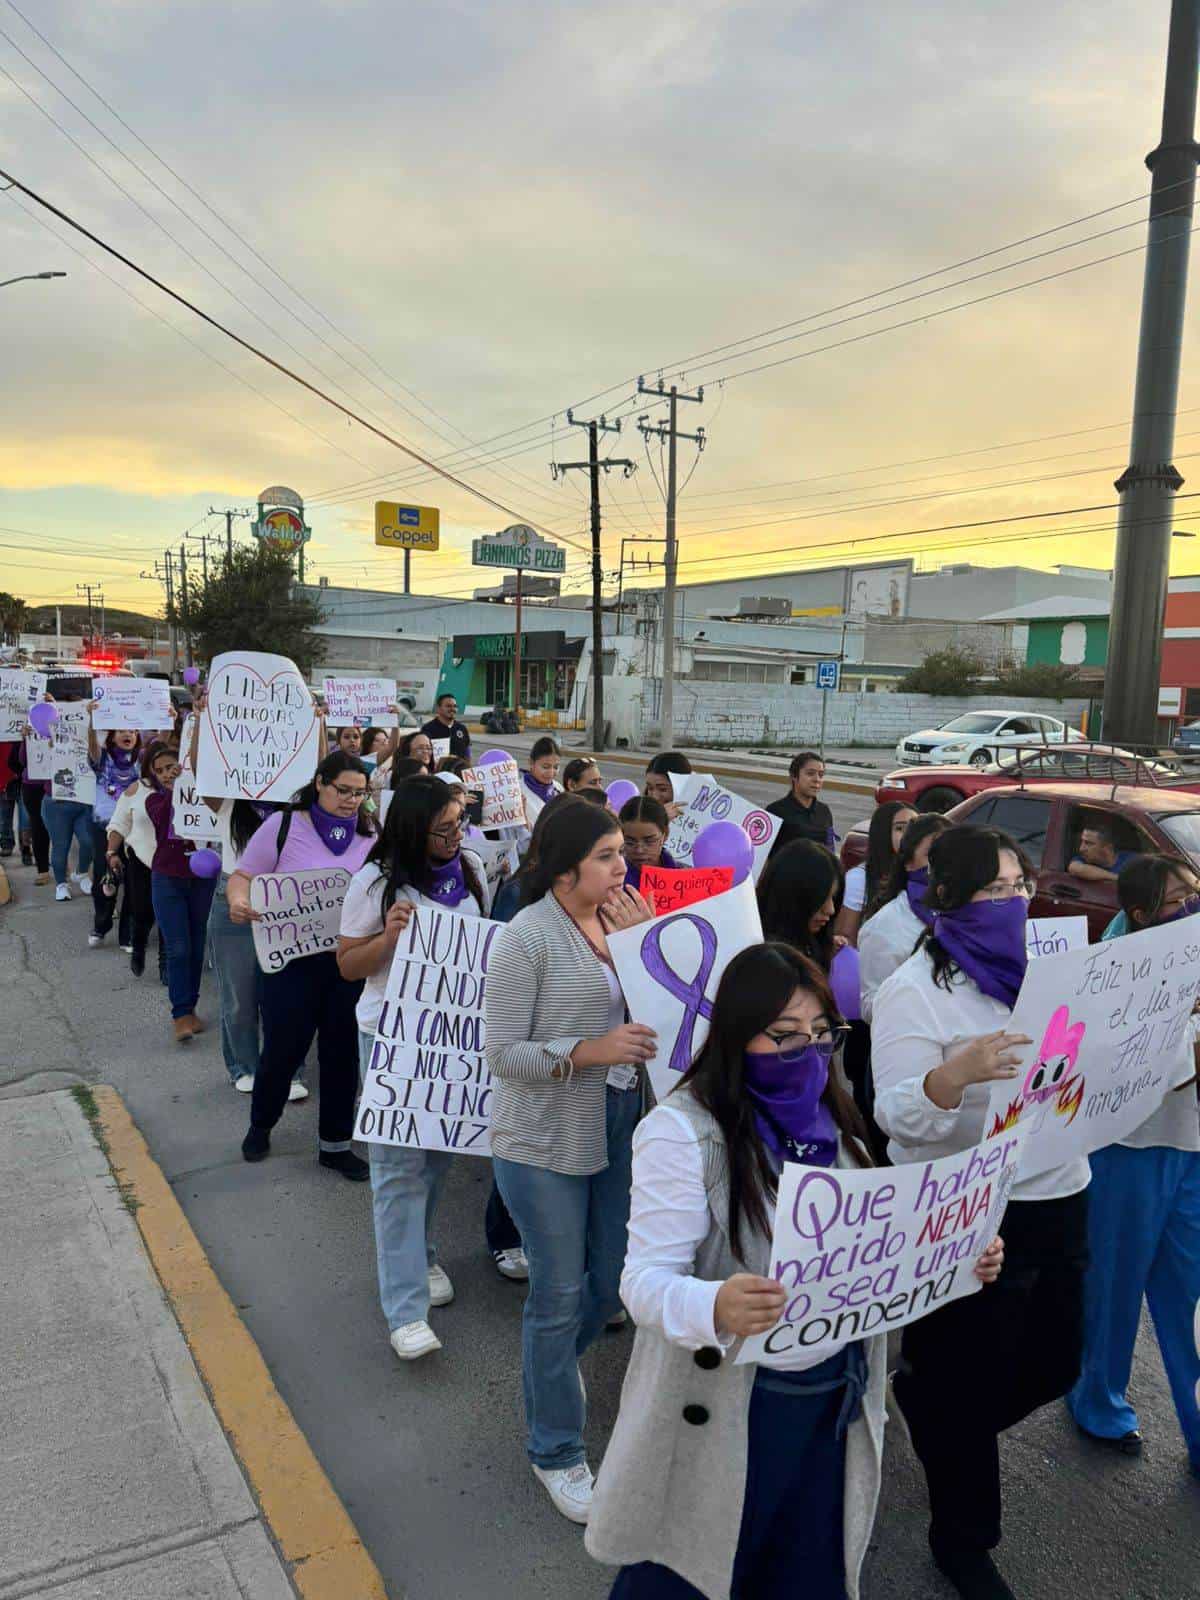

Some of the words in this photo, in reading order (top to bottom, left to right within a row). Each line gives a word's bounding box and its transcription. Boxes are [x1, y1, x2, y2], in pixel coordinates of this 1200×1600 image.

[381, 525, 433, 545] Coppel
[535, 548, 564, 569] PIZZA
[225, 675, 304, 709] LIBRES
[218, 703, 295, 726] PODEROSAS
[257, 750, 282, 769] SIN
[224, 768, 273, 792] MIEDO
[690, 784, 733, 821] NO
[644, 872, 667, 891] No
[378, 1000, 406, 1042] LA
[371, 1040, 402, 1074] DE
[359, 1107, 421, 1147] OTRA
[440, 1118, 489, 1149] VEZ
[792, 1171, 896, 1251] Que
[913, 1138, 1018, 1213] haber
[775, 1221, 906, 1289] nacido
[915, 1182, 993, 1249] NENA
[821, 1264, 900, 1313] sea
[914, 1229, 977, 1280] una
